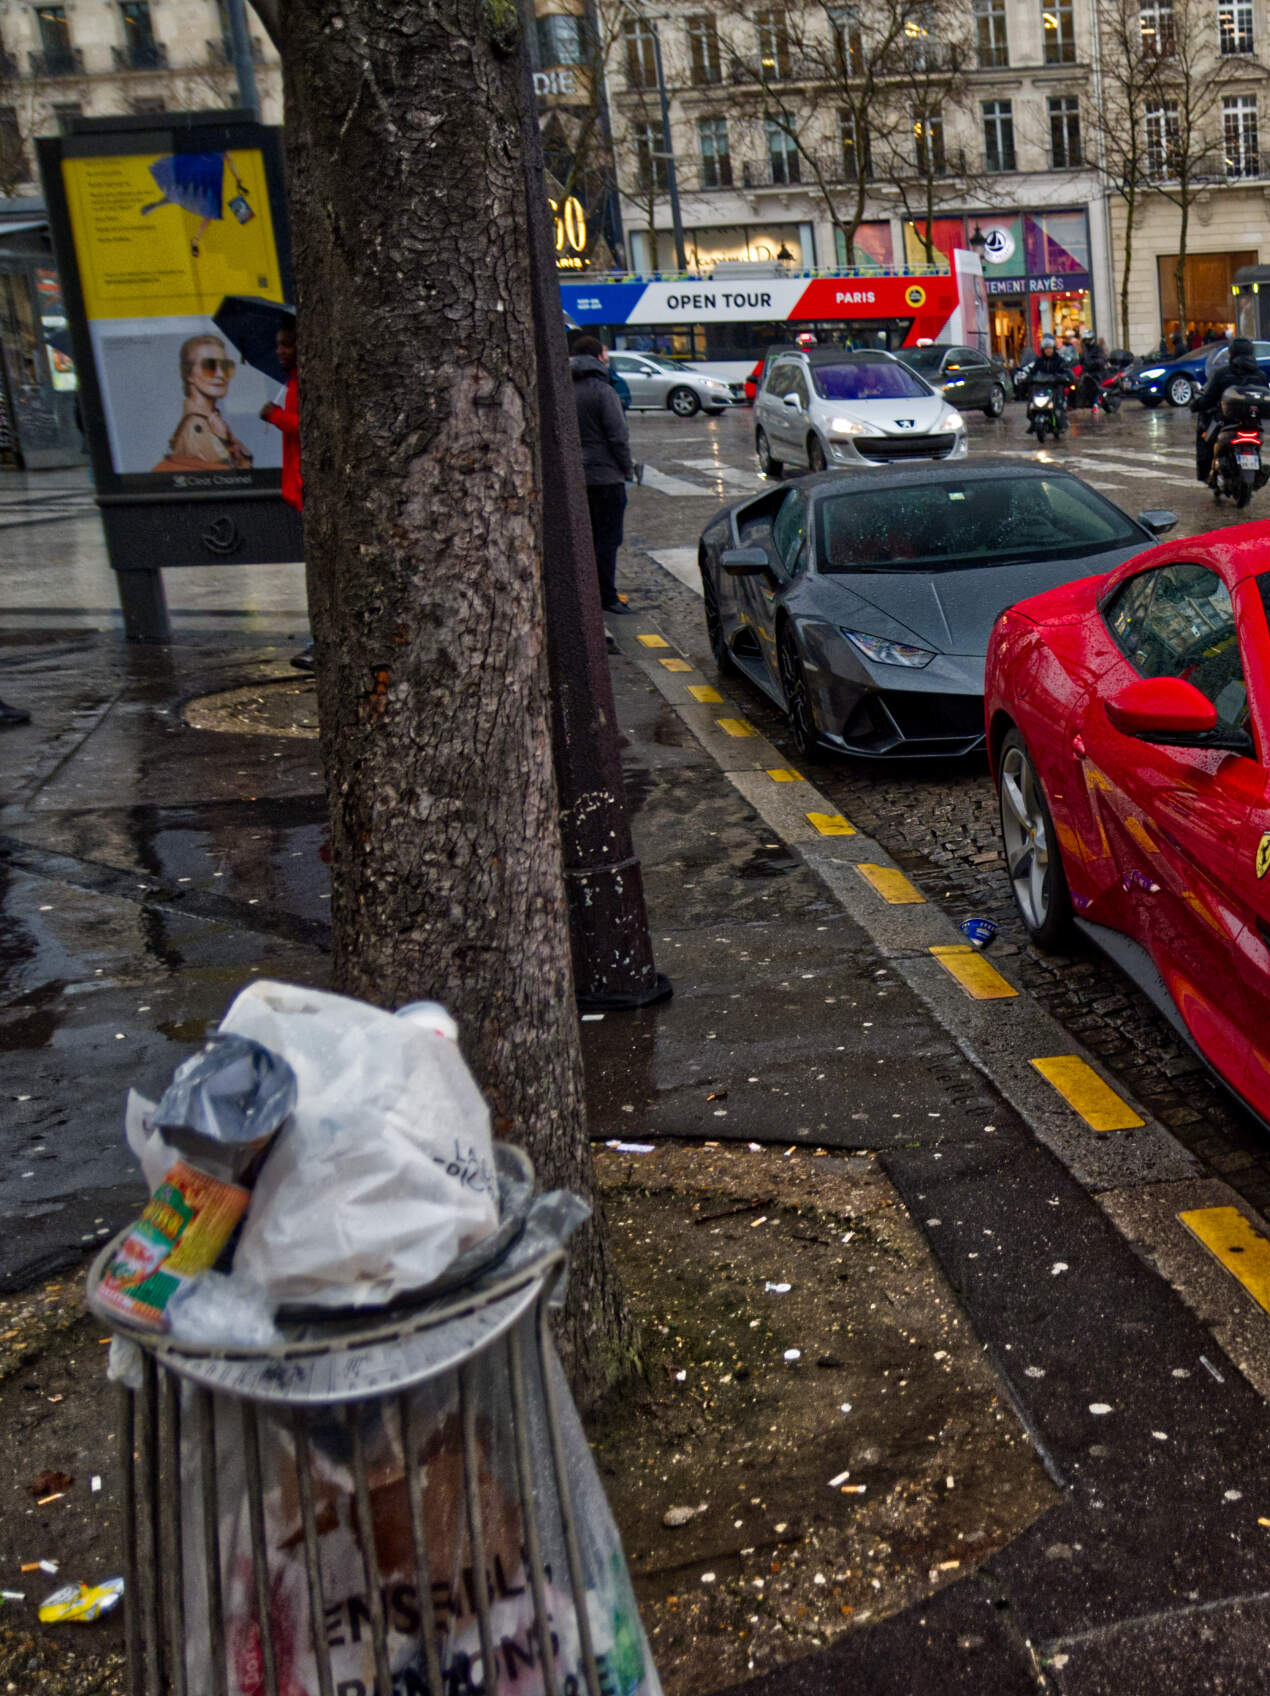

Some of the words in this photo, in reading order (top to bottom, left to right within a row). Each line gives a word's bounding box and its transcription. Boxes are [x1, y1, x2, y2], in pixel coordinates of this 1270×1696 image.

[1029, 276, 1064, 292] RAYÉS
[667, 295, 716, 309] OPEN
[722, 293, 771, 308] TOUR
[836, 291, 875, 304] PARIS
